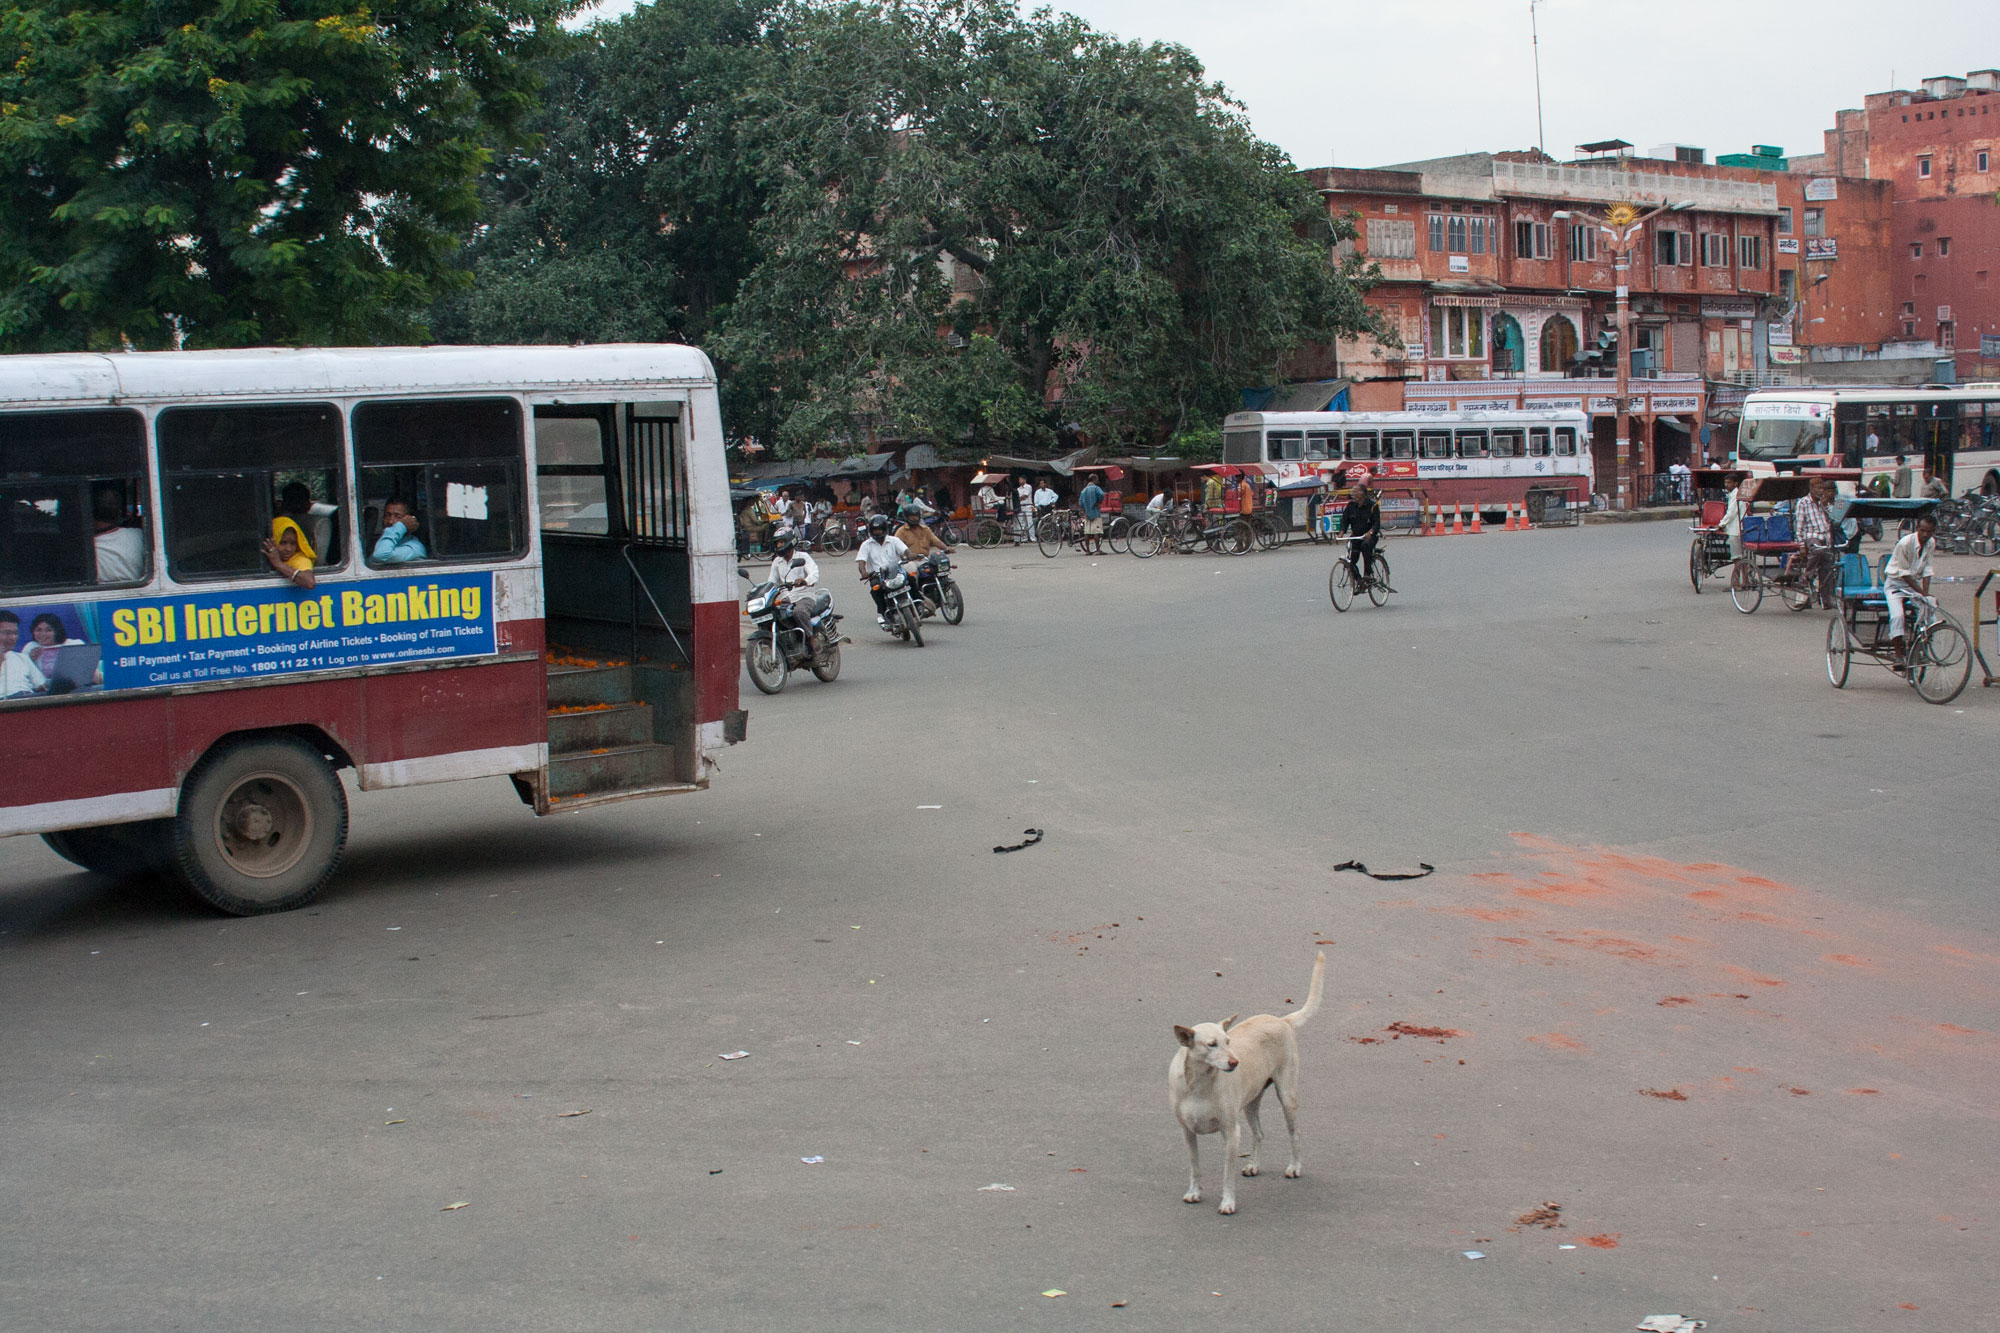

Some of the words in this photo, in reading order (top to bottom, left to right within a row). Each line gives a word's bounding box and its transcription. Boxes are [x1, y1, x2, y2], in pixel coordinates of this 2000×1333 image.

[112, 605, 176, 647] SBI
[184, 595, 335, 642] Internet
[341, 584, 481, 627] Banking
[120, 656, 137, 668] Bill
[138, 653, 181, 667] Payment
[188, 651, 206, 661] Tax
[208, 647, 249, 661] Payment
[257, 643, 297, 655] Booking
[298, 640, 308, 650] of
[309, 637, 339, 650] Airline
[341, 635, 373, 646] Tickets
[380, 631, 417, 643] Booking
[419, 629, 428, 639] of
[430, 627, 452, 638] Train
[454, 625, 483, 636] Tickets
[149, 672, 168, 682] Call
[169, 672, 181, 680] us
[182, 669, 191, 679] at
[193, 667, 207, 678] Toll
[210, 666, 231, 676] Free
[233, 664, 249, 674] No.
[251, 660, 277, 672] 1800
[280, 659, 293, 669] 11
[295, 658, 308, 667] 22
[311, 656, 324, 666] 11
[328, 655, 345, 666] Log
[347, 654, 358, 663] on
[361, 652, 370, 661] to
[371, 644, 455, 660] www.onlinesbi.com
